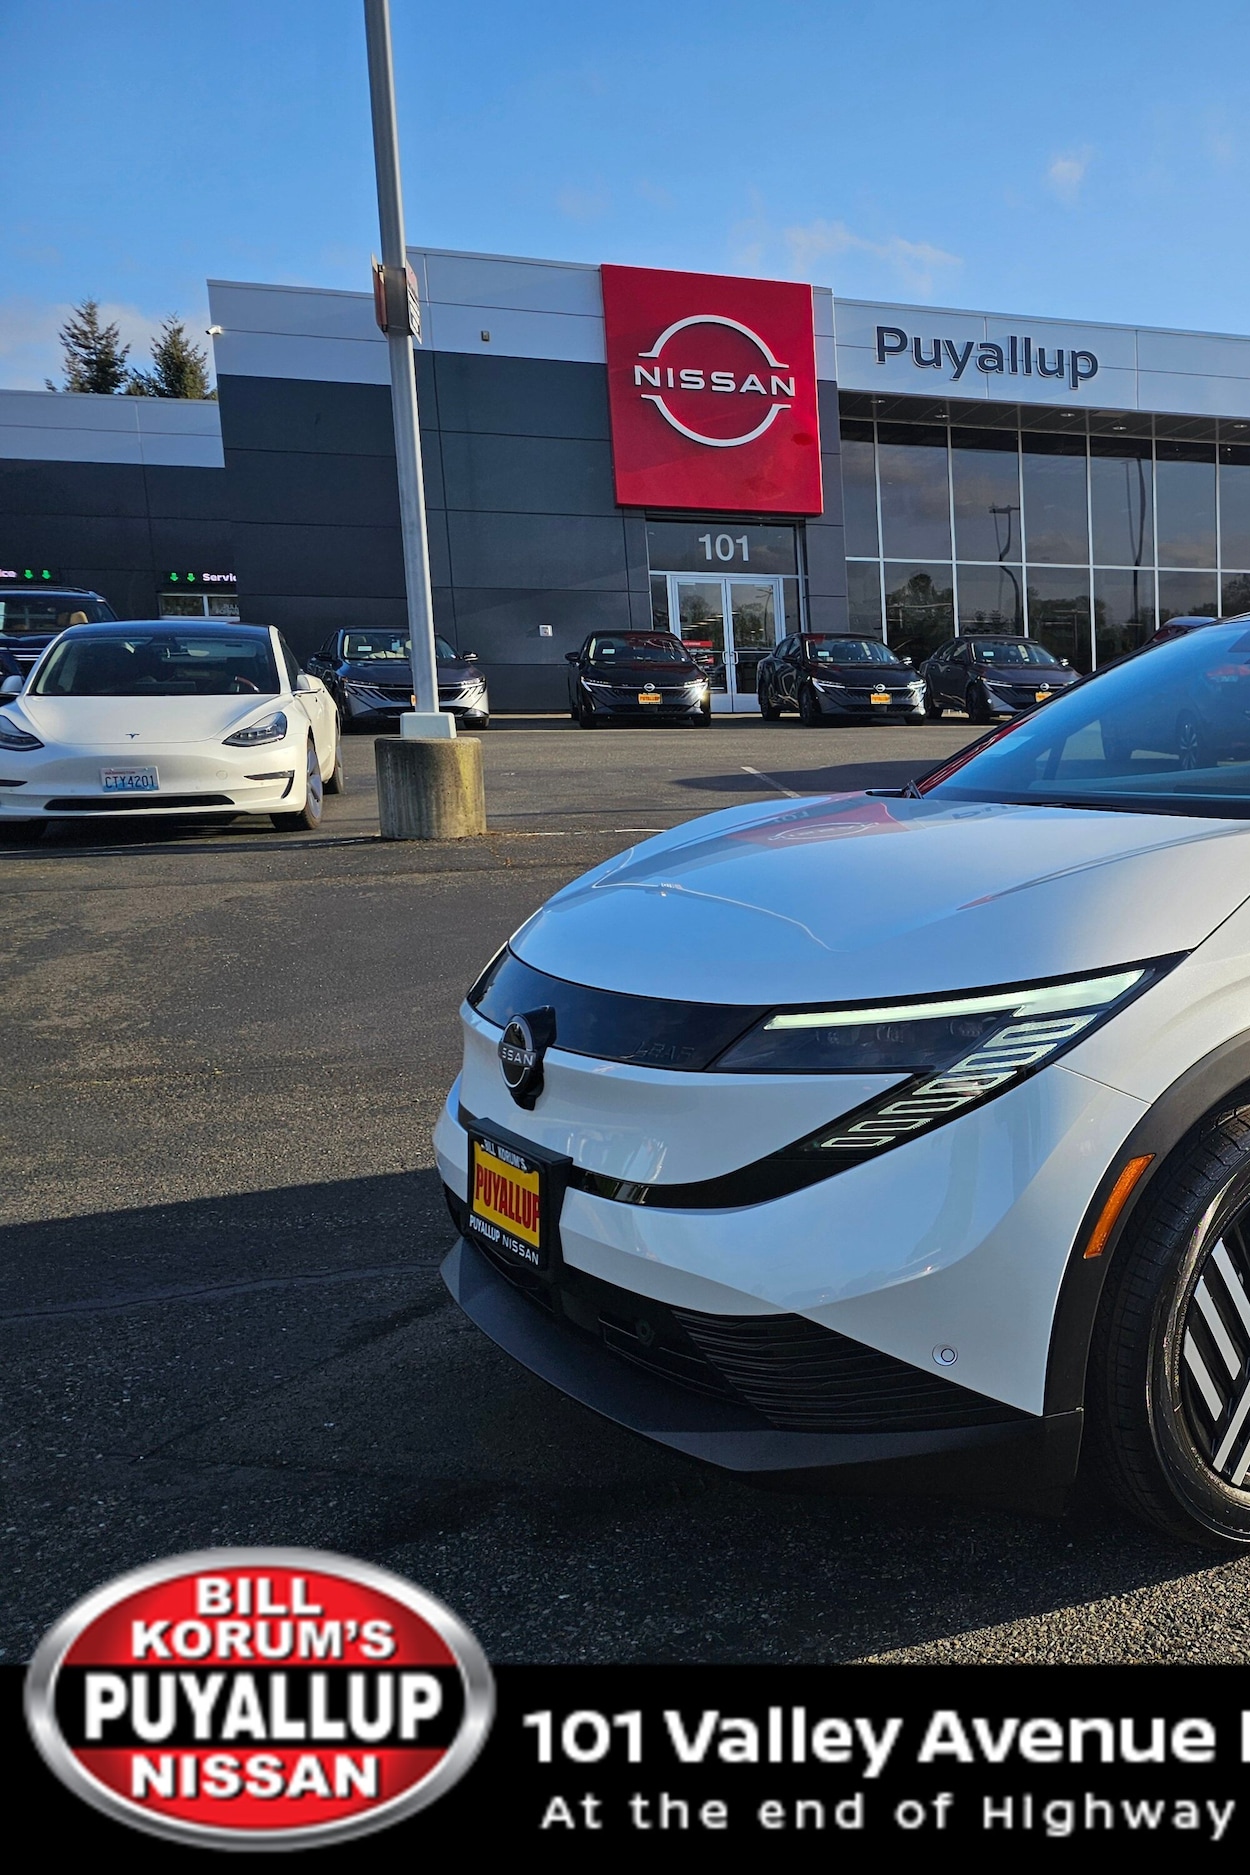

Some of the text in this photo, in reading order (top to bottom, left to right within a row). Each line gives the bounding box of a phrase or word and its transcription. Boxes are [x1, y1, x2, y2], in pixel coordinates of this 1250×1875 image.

[875, 324, 1099, 390] Puyallup
[634, 364, 795, 398] NISSAN
[698, 533, 750, 563] 101
[105, 775, 154, 788] CTY4201
[483, 1138, 497, 1156] BILL
[476, 1163, 540, 1233] PUYALLUP
[469, 1214, 539, 1265] PUYALLUP NISSAN
